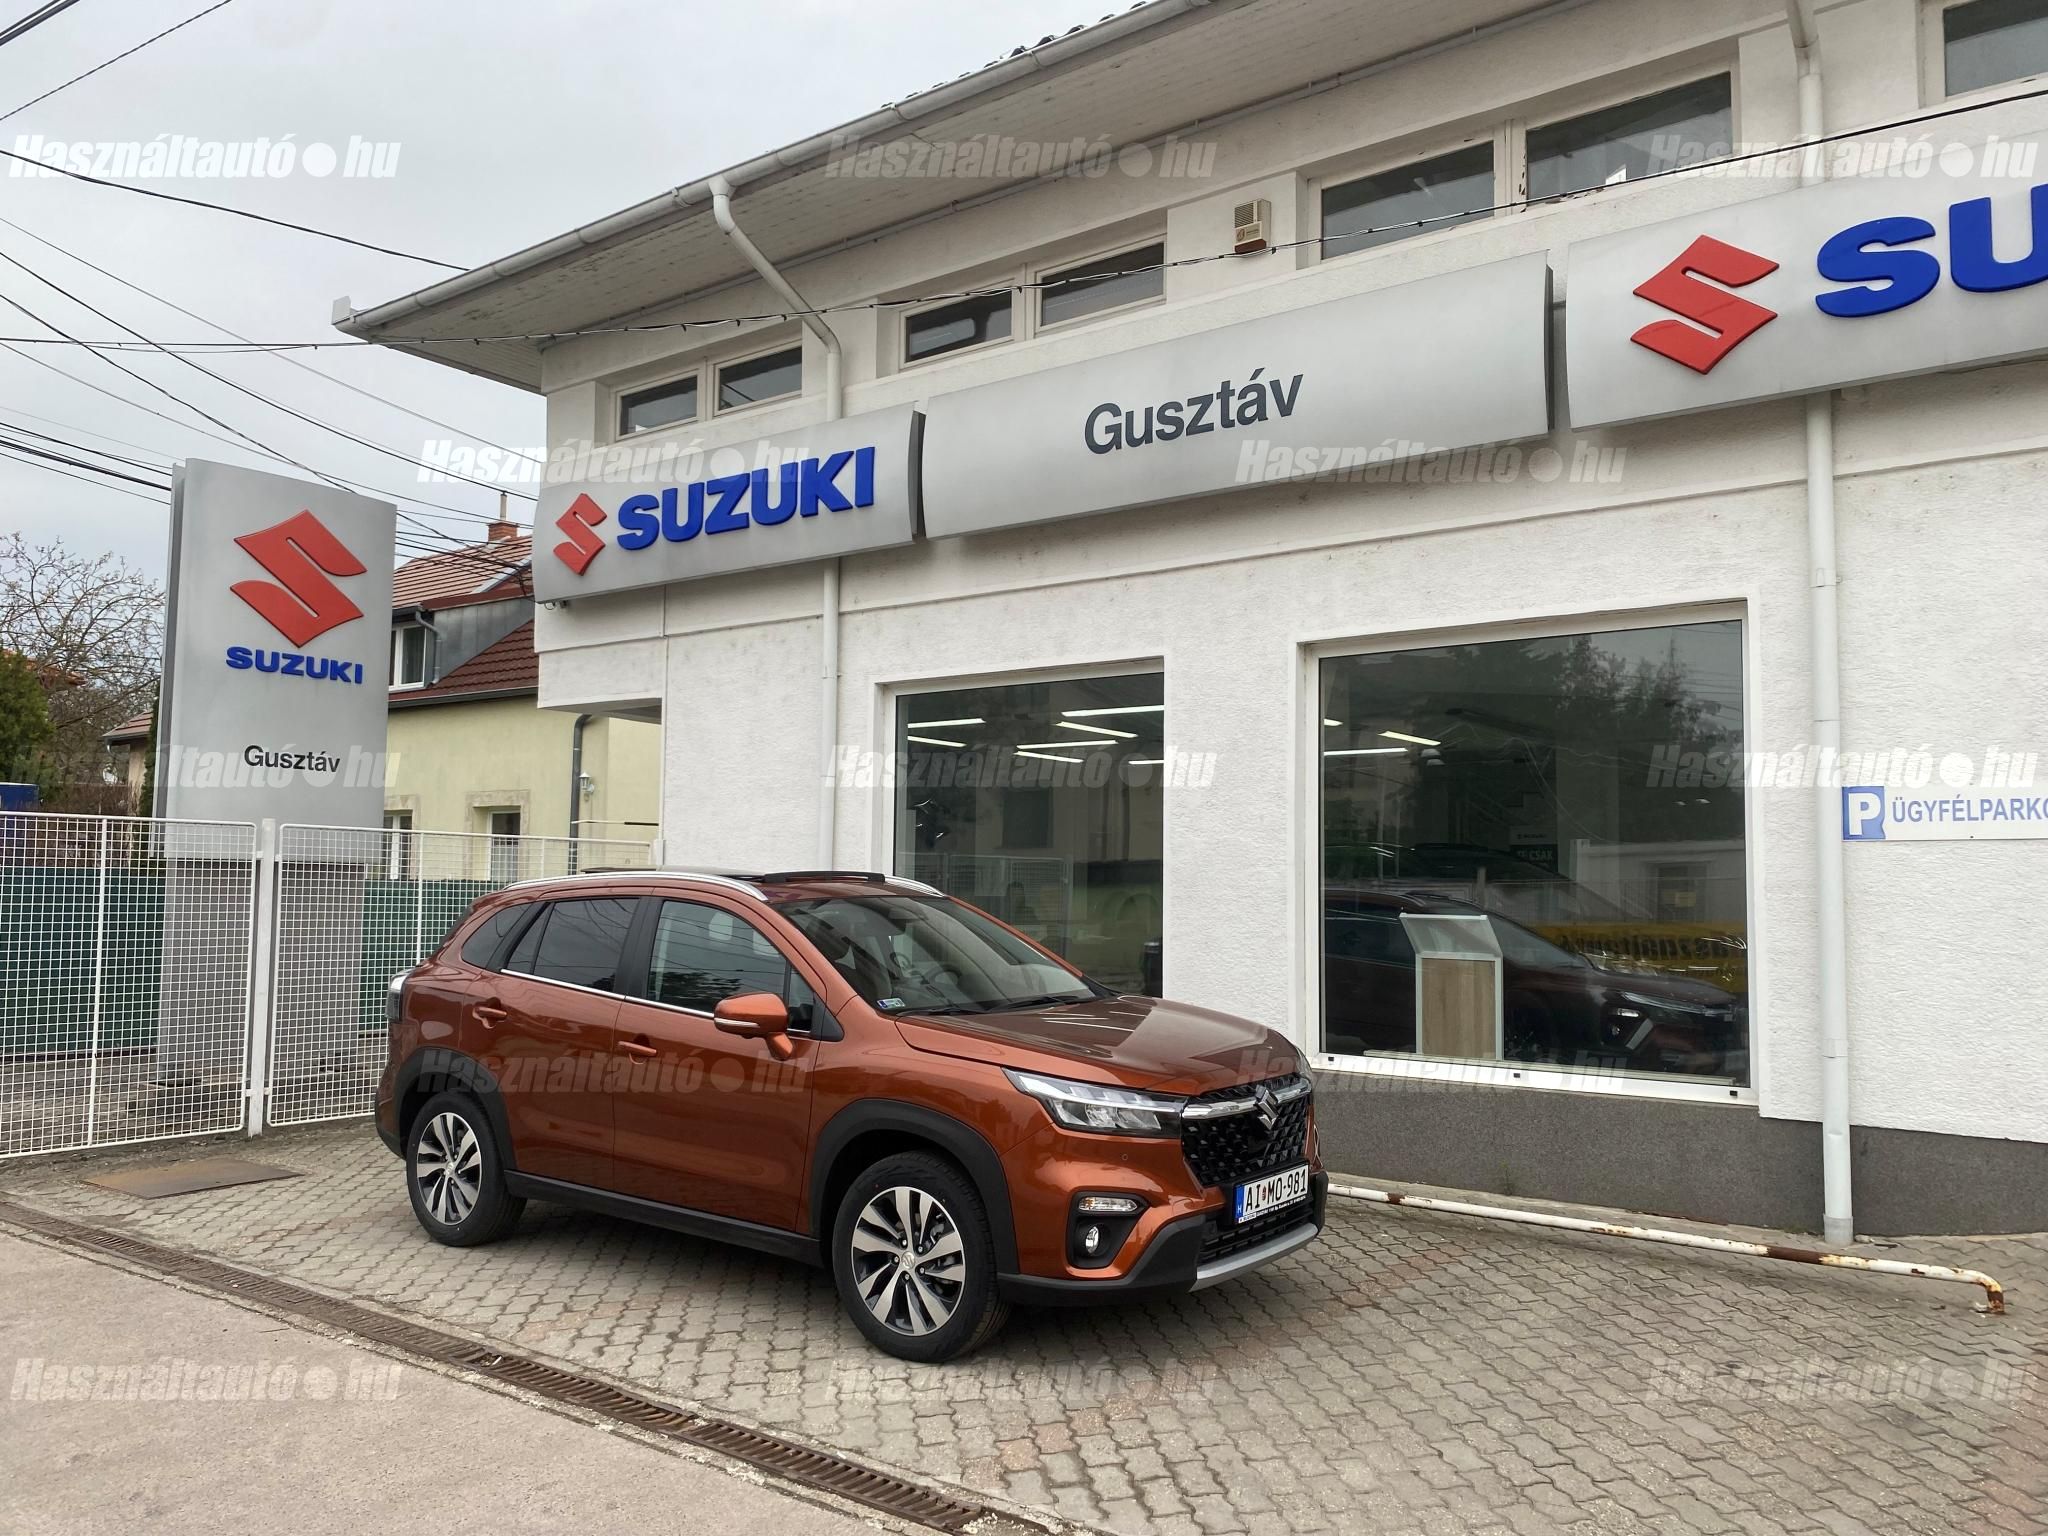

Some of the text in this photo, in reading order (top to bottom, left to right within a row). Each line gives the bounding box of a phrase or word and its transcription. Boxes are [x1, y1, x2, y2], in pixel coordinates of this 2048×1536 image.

[1086, 369, 1304, 455] Gusztáv
[617, 446, 875, 551] SUZUKI
[226, 646, 363, 684] SUZUKI
[244, 745, 341, 773] Gusztáv
[1848, 792, 1882, 836] P
[1267, 1168, 1306, 1204] MO-981
